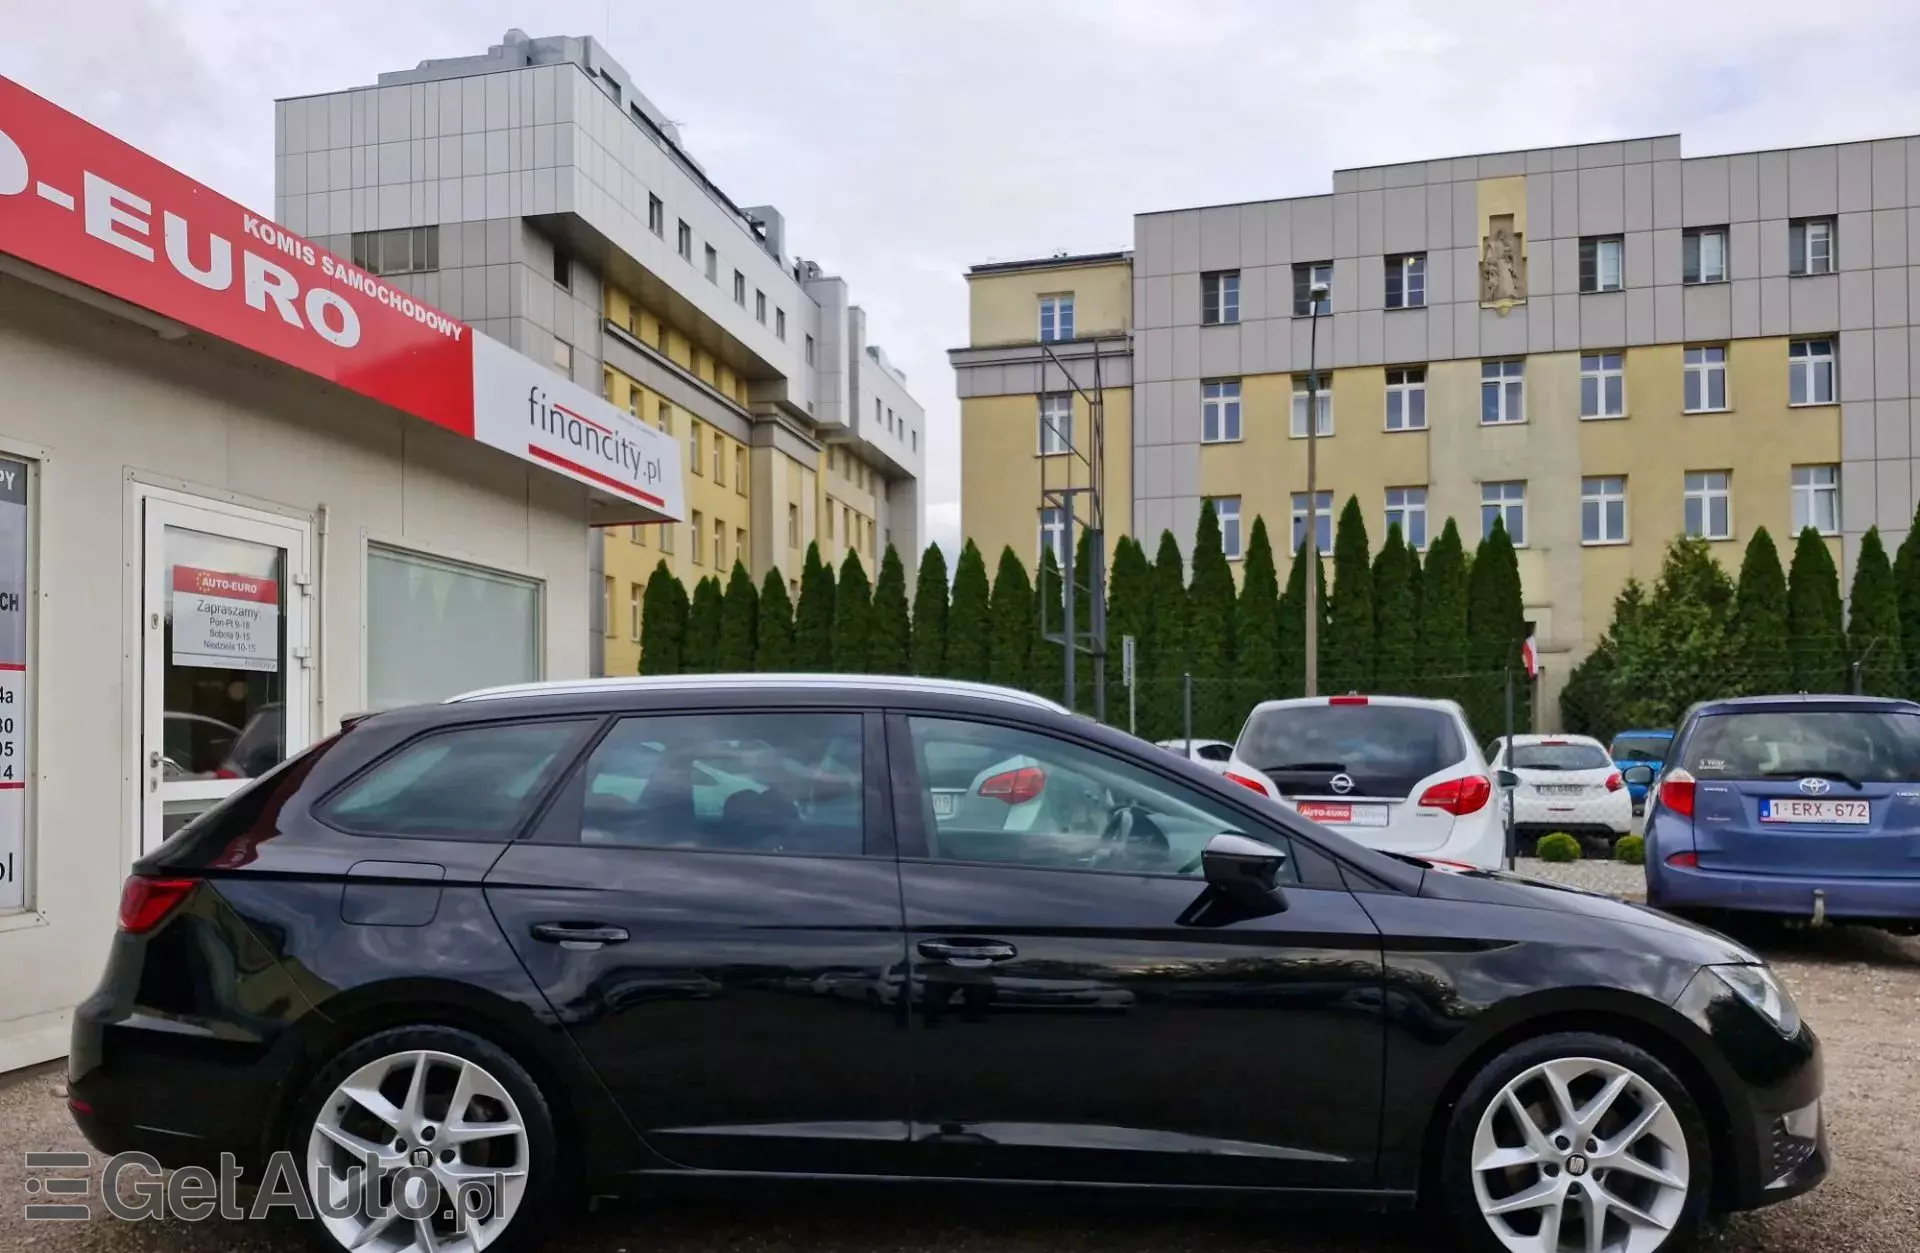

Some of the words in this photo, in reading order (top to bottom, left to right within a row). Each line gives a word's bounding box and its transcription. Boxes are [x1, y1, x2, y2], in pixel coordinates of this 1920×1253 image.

[243, 213, 316, 266] KOMIS
[321, 254, 463, 341] SAMOCHODOWY
[528, 385, 662, 485] financity.pl
[202, 577, 257, 594] AUTO-EURO
[237, 643, 257, 653] 10-15
[0, 741, 14, 757] 5
